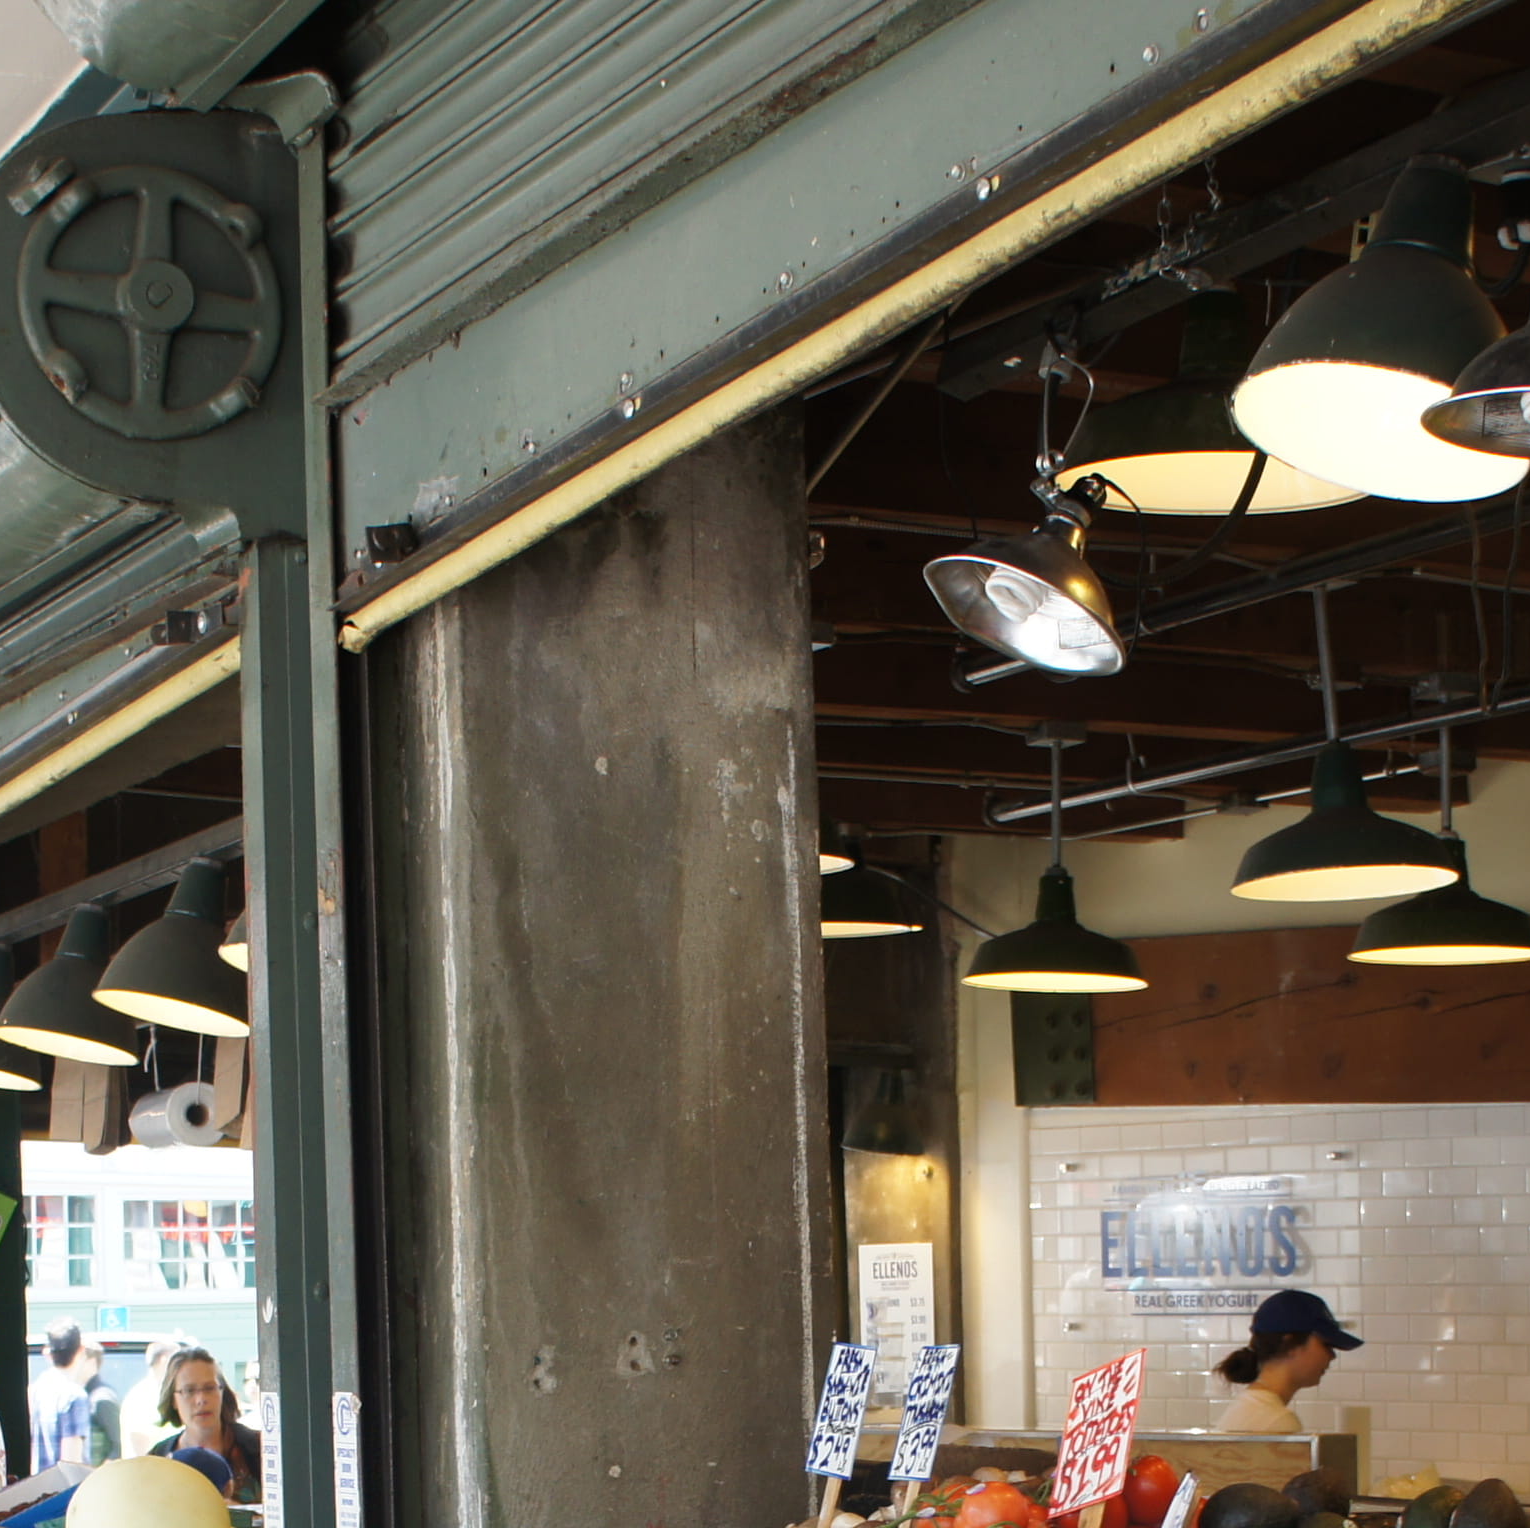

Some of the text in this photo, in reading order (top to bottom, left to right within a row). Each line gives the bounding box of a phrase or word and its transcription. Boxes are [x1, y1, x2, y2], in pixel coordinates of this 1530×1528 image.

[1100, 1205, 1297, 1278] ELLENOS
[872, 1260, 919, 1280] ELLENOS
[1134, 1293, 1259, 1309] REAL GREEK YOGURT
